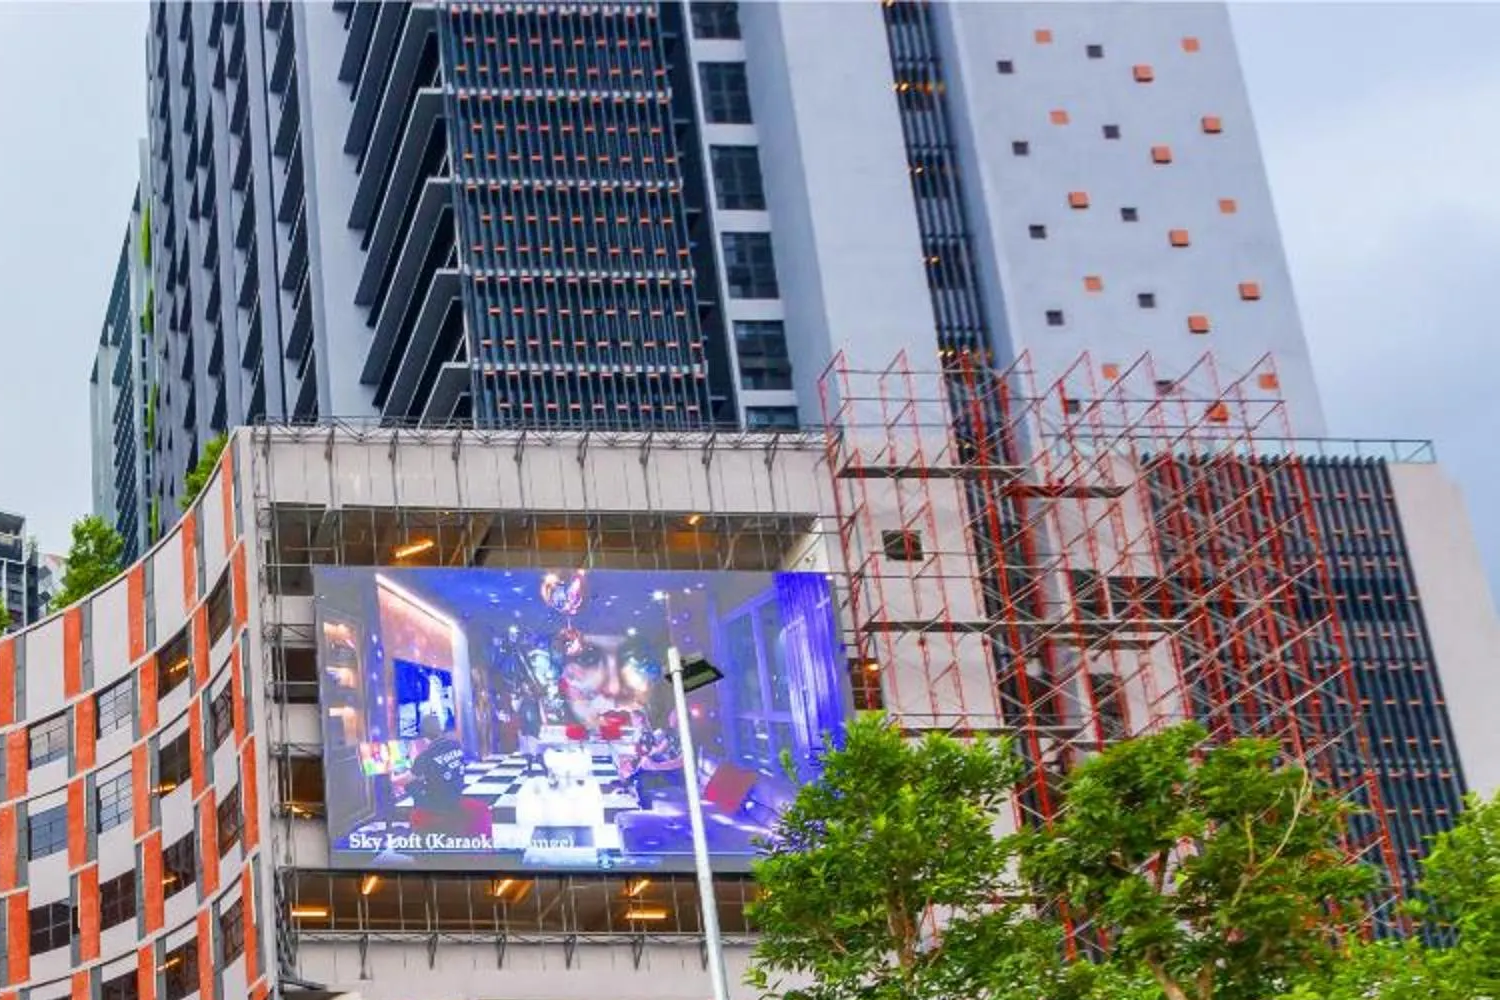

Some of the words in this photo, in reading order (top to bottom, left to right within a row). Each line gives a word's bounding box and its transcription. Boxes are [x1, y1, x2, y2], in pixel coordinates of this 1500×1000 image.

[350, 832, 382, 851] Sky
[386, 832, 422, 849] Loft
[425, 832, 500, 850] (Karaok
